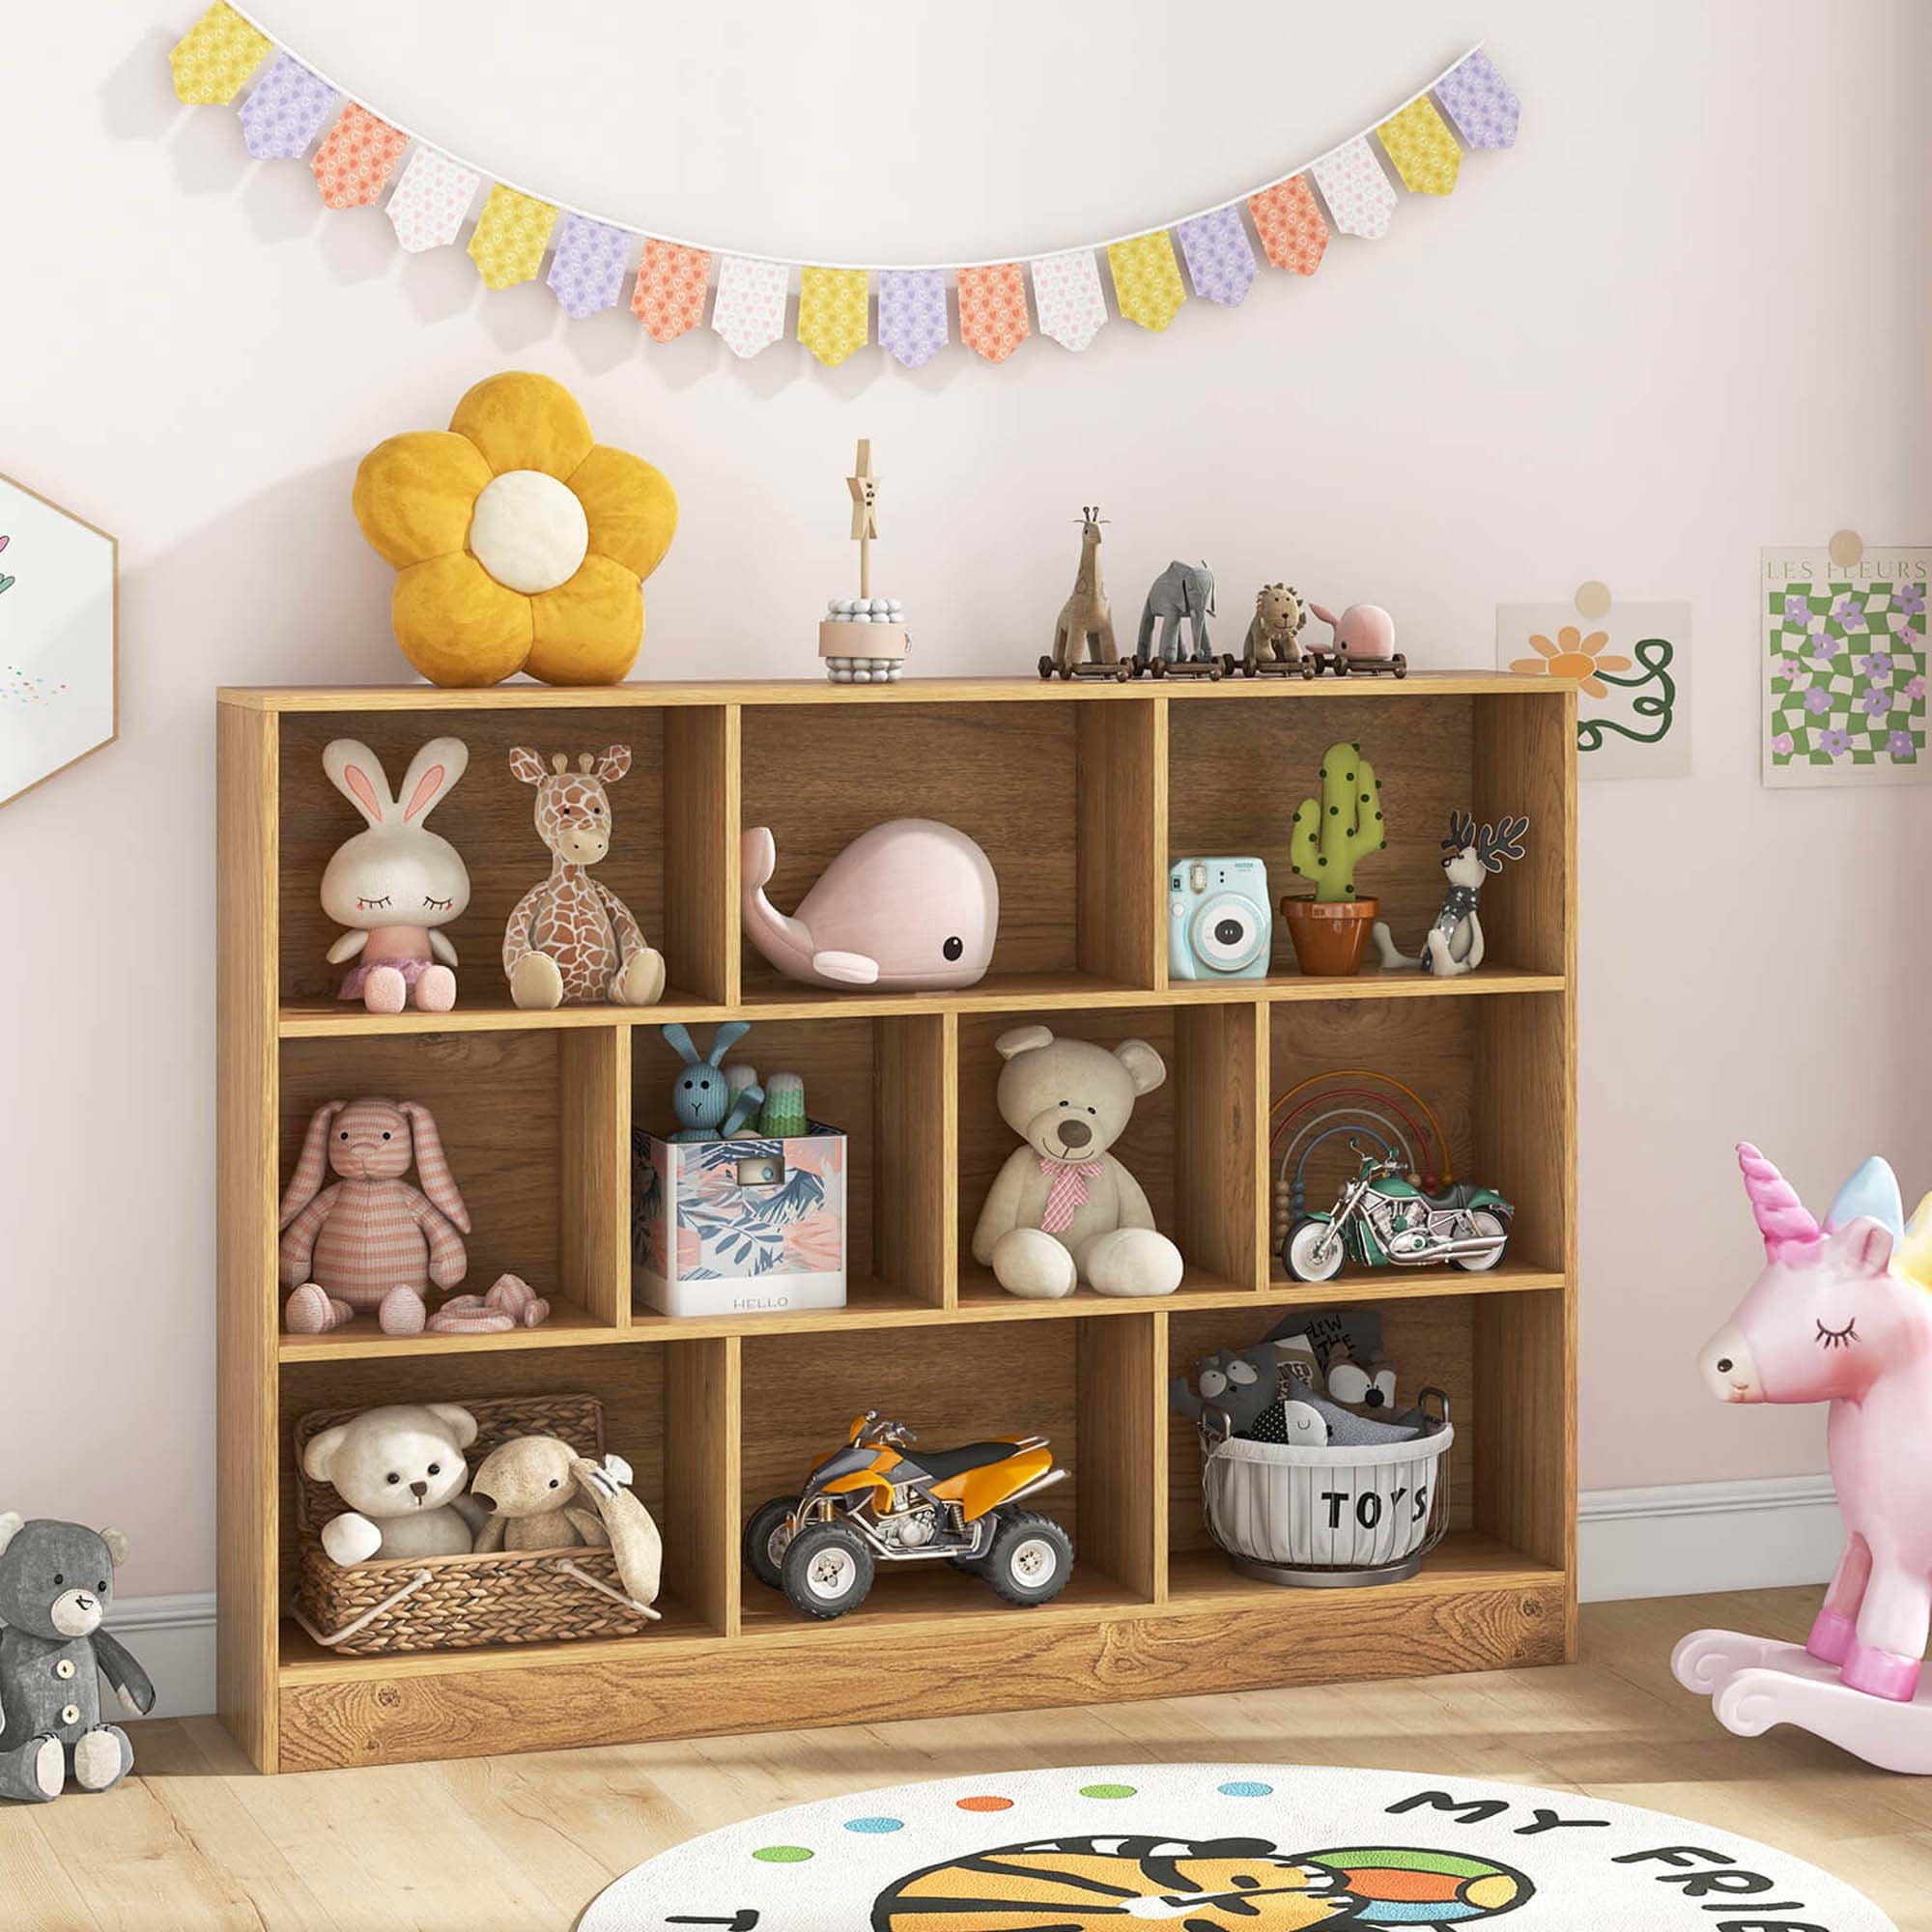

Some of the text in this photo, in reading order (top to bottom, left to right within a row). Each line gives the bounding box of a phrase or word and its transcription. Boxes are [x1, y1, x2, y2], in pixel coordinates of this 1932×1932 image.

[1768, 560, 1812, 579] LES
[733, 1297, 788, 1310] HELLO
[1321, 1486, 1427, 1529] TOYS
[1385, 1791, 1610, 1834] MY
